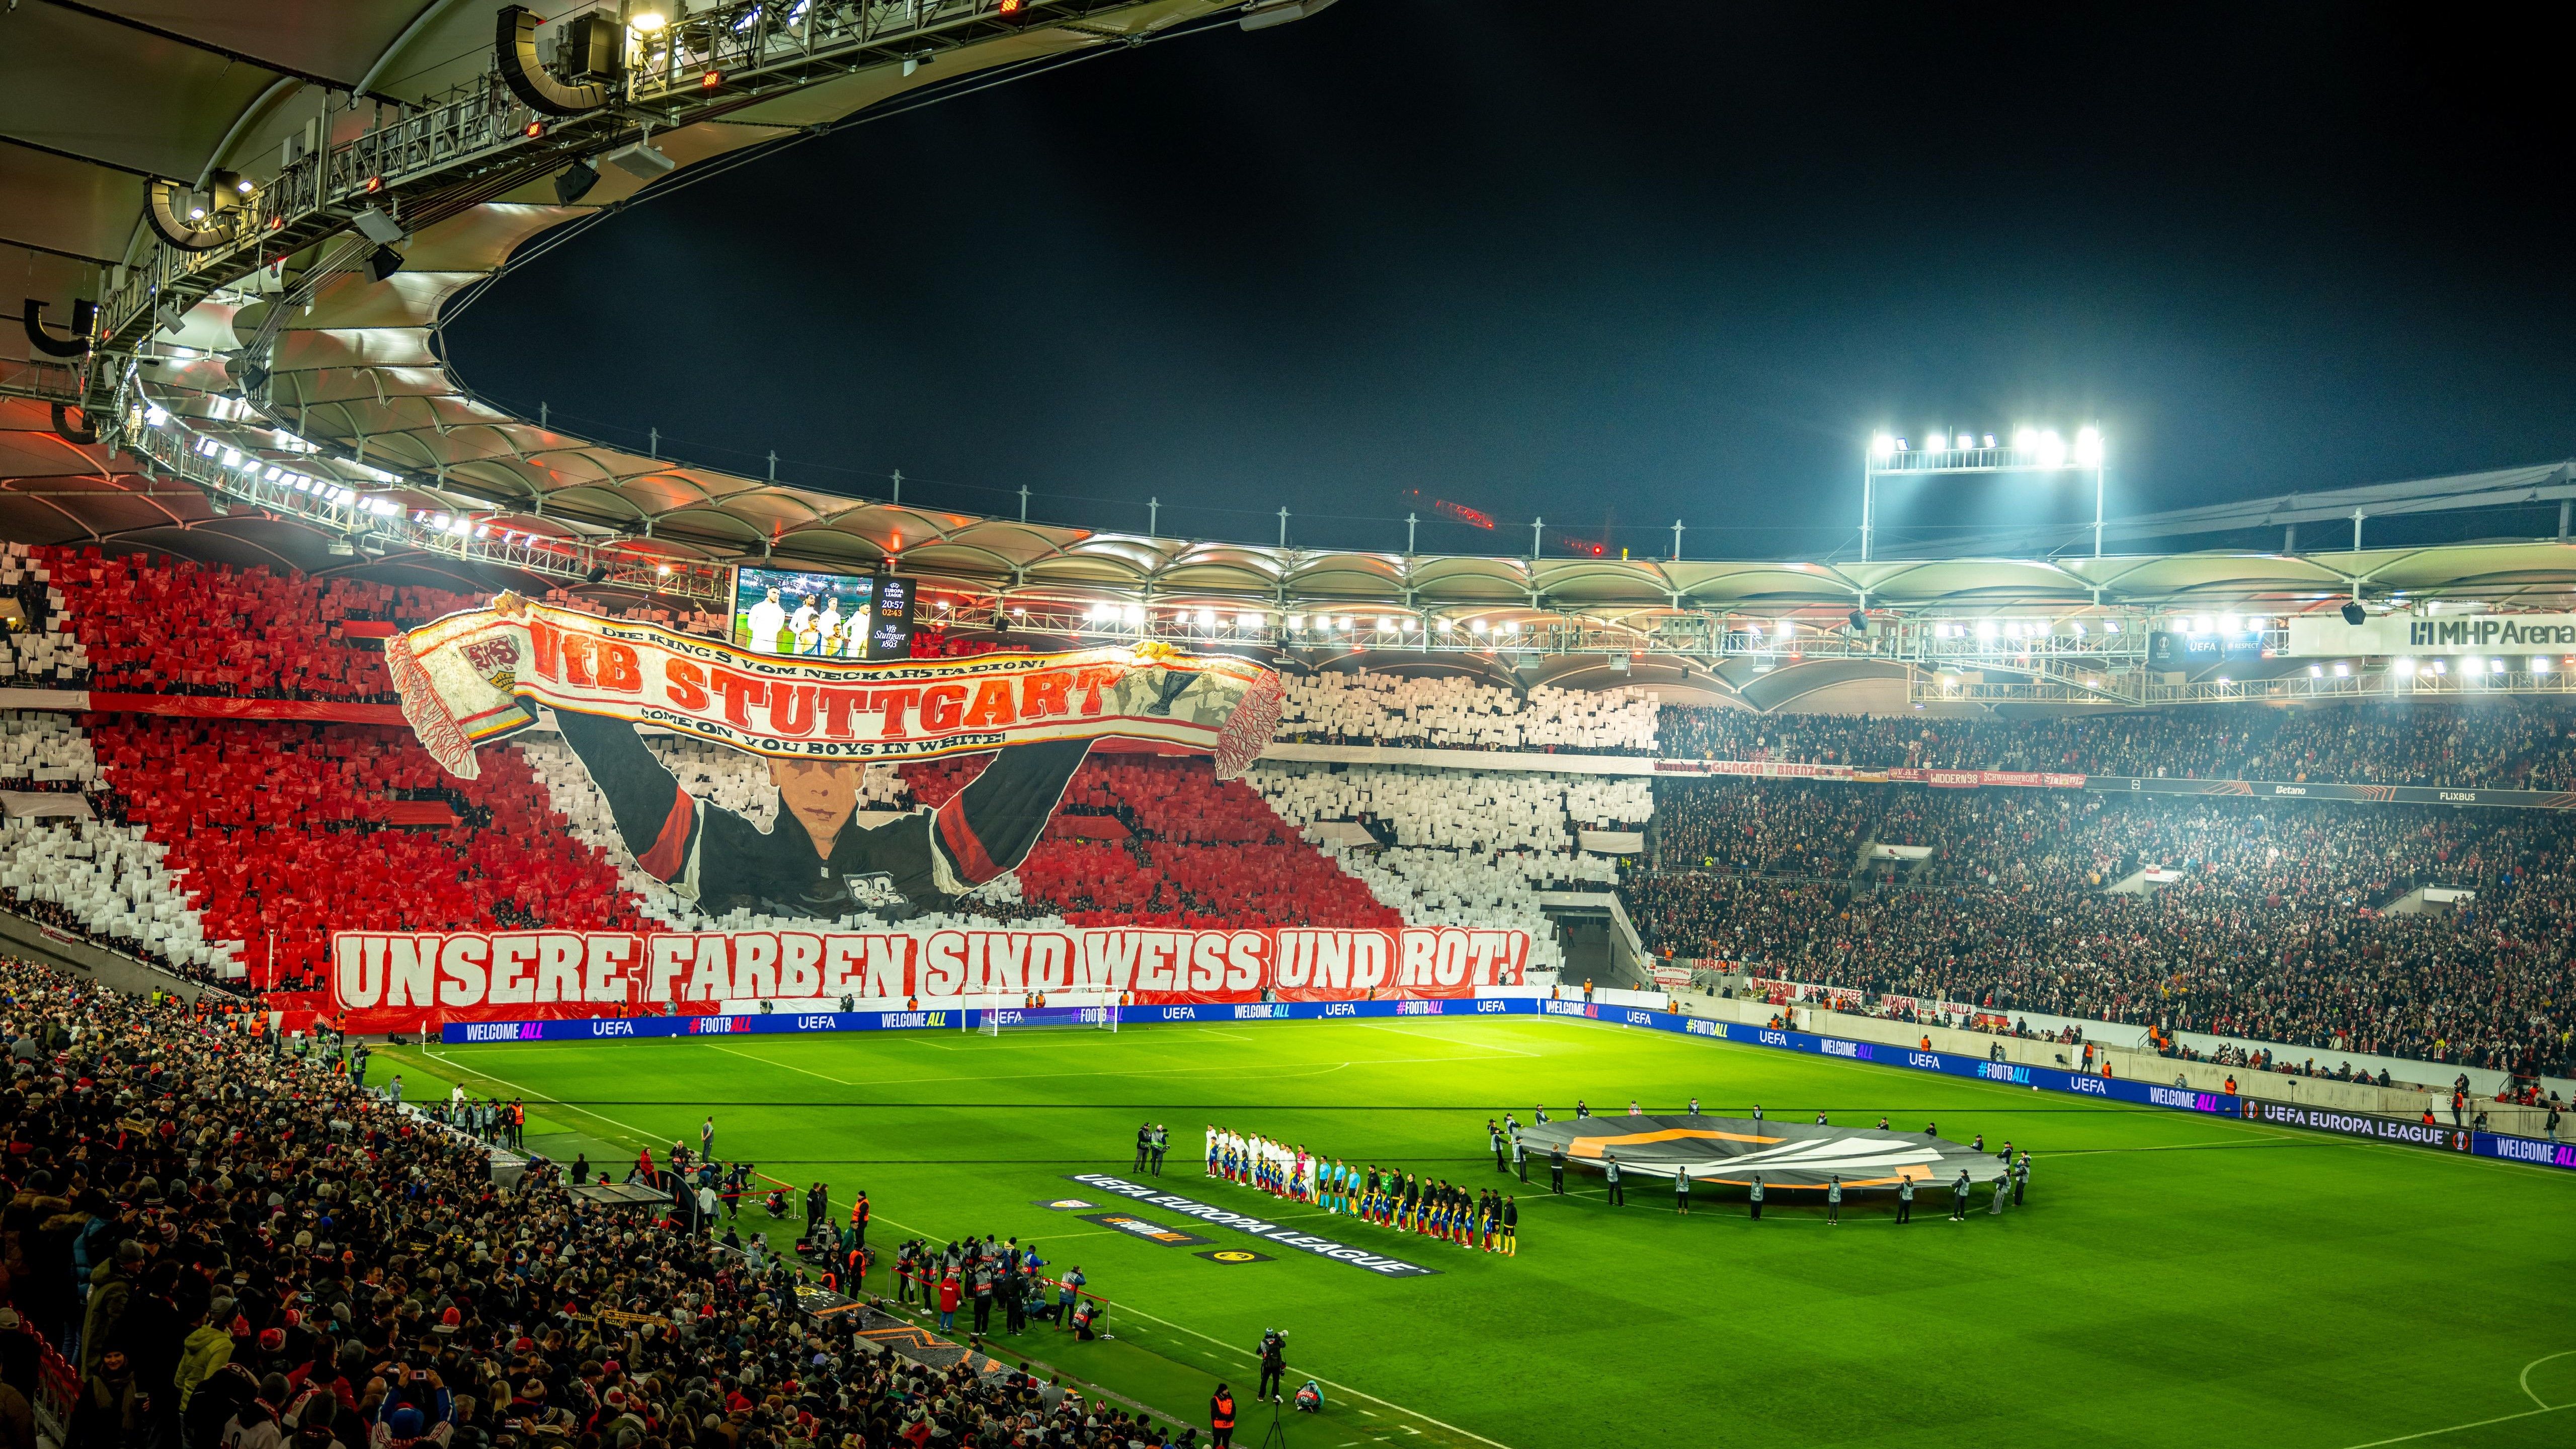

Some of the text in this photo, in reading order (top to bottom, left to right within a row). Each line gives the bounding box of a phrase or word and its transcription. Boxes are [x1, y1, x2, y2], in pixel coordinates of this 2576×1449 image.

[881, 600, 904, 609] 20:57
[874, 630, 906, 641] Stuttgart
[2439, 620, 2575, 645] MHP Arena
[602, 626, 1046, 683] DIE KINGS VOM NECKARSTADION!
[2190, 642, 2216, 651] UEFA
[531, 616, 1126, 739] VfB STUTTGART
[641, 707, 1007, 756] COME ON YOU BOYS IN WHITE!
[1777, 765, 1815, 776] BRENZ
[1984, 772, 2039, 783] SCHWABENFRONT
[2275, 785, 2306, 795] Betano
[338, 930, 1530, 1008] UNSERE FARBEN SIND WEISS UND ROT!
[1693, 958, 1739, 973] URBAH
[1325, 1004, 1356, 1016] UEFA
[1396, 1000, 1443, 1015] #FOOTBALL
[1477, 1000, 1506, 1012] UEFA
[1546, 1001, 1599, 1018] WELCOME ALL
[1882, 995, 1915, 1010] WANGEN
[989, 1010, 1022, 1025] UEFA
[1072, 1008, 1123, 1022] #FOOTBALL
[1163, 1007, 1195, 1019] UEFA
[1234, 1004, 1290, 1018] WELCOME ALL
[1627, 1010, 1652, 1025] UEFA
[593, 1021, 634, 1035] UEFA
[688, 1016, 751, 1033] #FOOTBALL
[798, 1015, 836, 1029] UEFA
[881, 1012, 945, 1028] WELCOME ALL
[1686, 1018, 1728, 1038] #FOOTBALL
[467, 1022, 543, 1040] WELCOME ALL
[1759, 1030, 1787, 1046] UEFA
[1821, 1038, 1873, 1060] WELCOME ALL
[1909, 1052, 1941, 1069] UEFA
[1977, 1062, 2030, 1084] #FOOTBALL
[2071, 1076, 2107, 1095] UEFA
[2150, 1087, 2216, 1112] WELCOME ALL
[2264, 1105, 2306, 1124] UEFA
[2310, 1111, 2374, 1135] EUROPA
[2497, 1137, 2554, 1163] WELCOME
[1073, 1174, 1166, 1197] UEFA
[1153, 1195, 1276, 1233] EUROPA
[1102, 1217, 1193, 1242] #FOOTBALL
